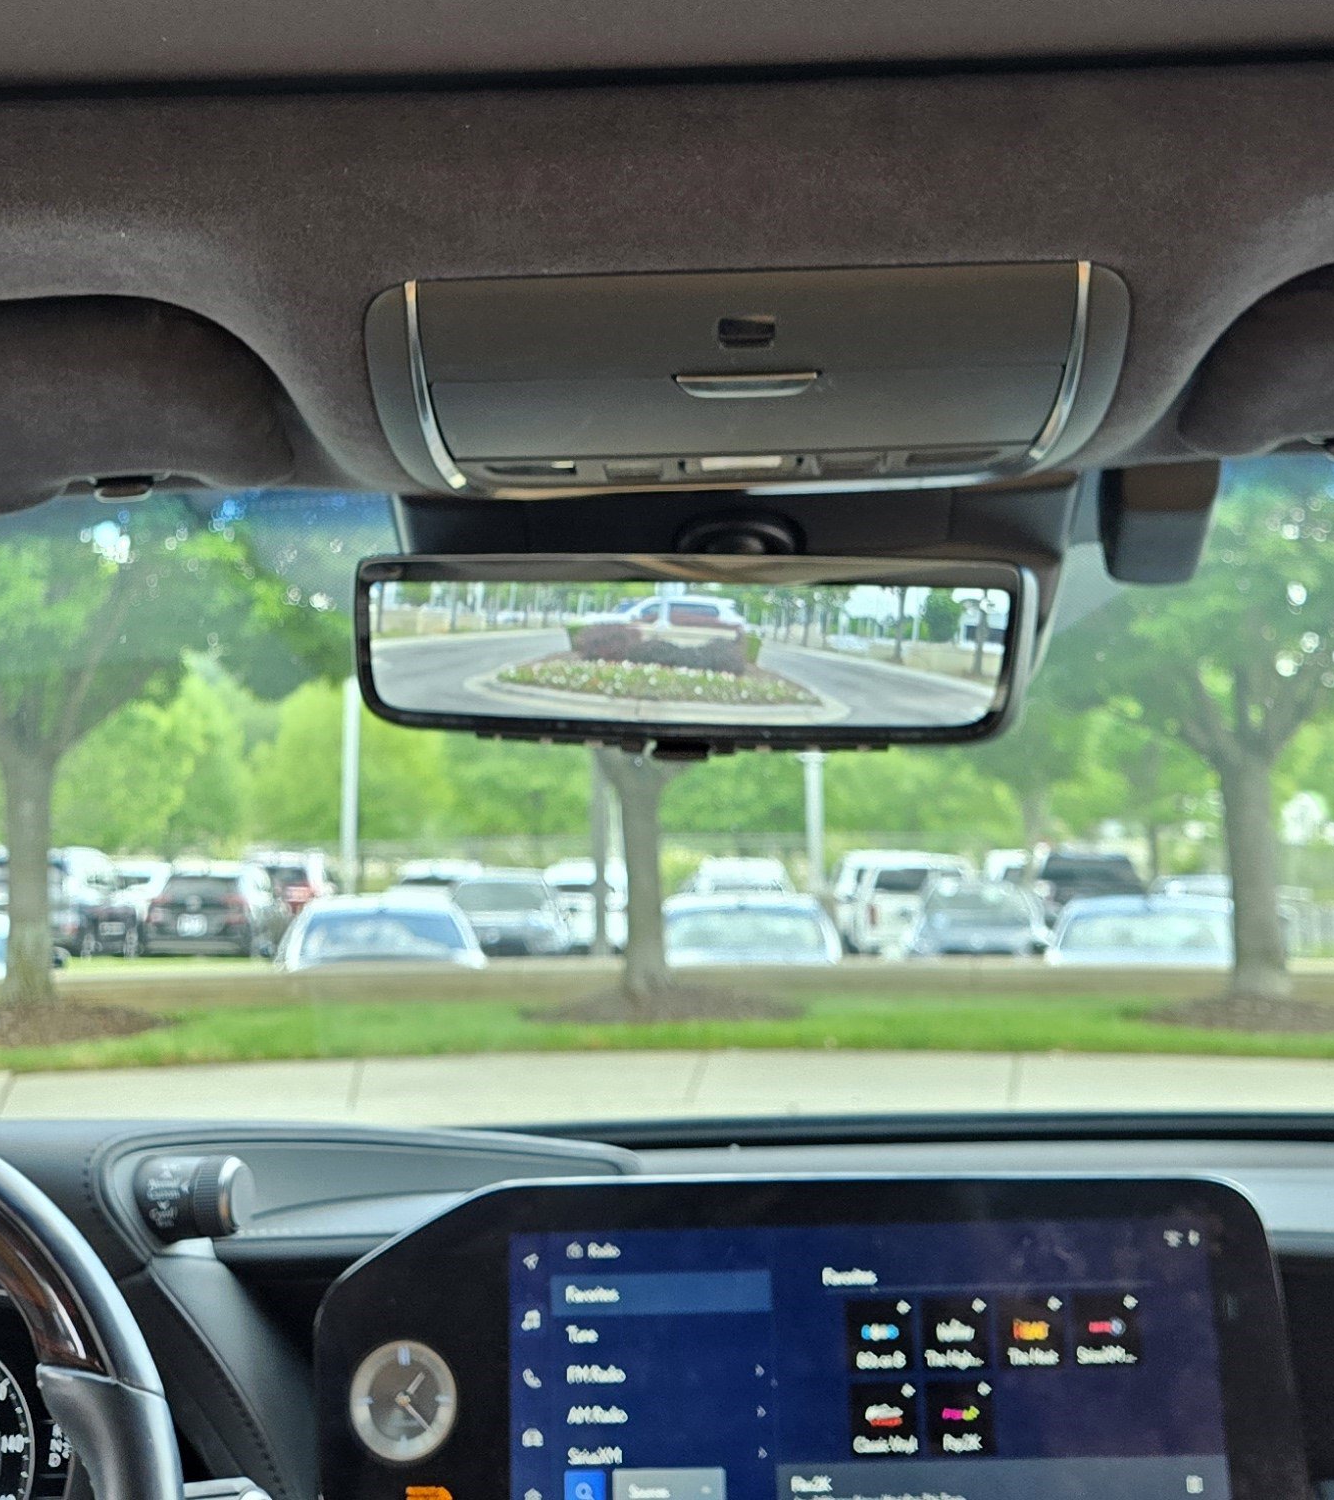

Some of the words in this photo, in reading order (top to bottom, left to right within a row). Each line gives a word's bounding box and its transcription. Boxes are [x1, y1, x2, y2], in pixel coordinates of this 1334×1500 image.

[588, 1241, 621, 1259] Radio
[822, 1267, 878, 1286] Favorites
[565, 1285, 620, 1303] Favorites
[590, 1364, 627, 1384] Radio
[567, 1405, 592, 1424] AM
[592, 1405, 628, 1424] Radio
[0, 1434, 25, 1454] 140
[50, 1438, 63, 1453] N
[48, 1453, 61, 1467] D
